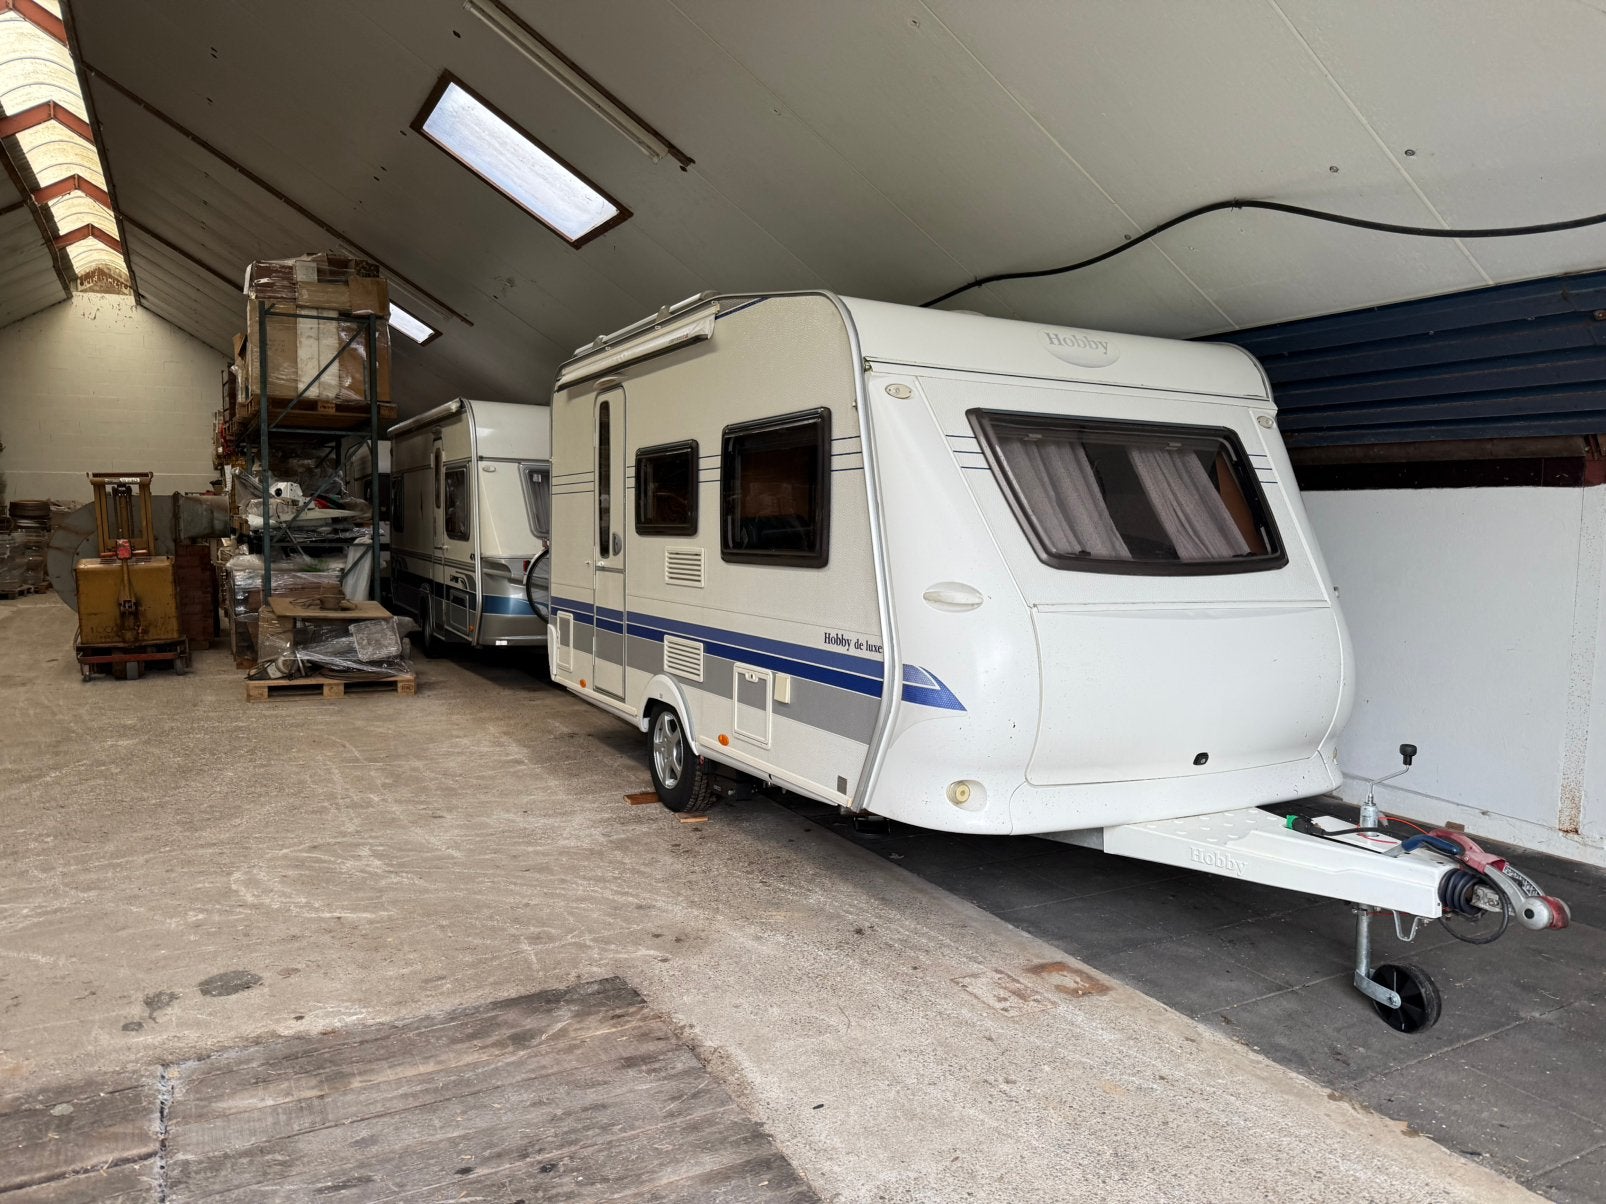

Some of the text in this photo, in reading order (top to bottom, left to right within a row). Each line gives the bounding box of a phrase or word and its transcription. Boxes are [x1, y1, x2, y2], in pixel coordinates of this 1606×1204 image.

[1043, 331, 1108, 355] Hobby
[824, 632, 883, 654] Hobby de luxe
[1190, 847, 1247, 877] Hobby
